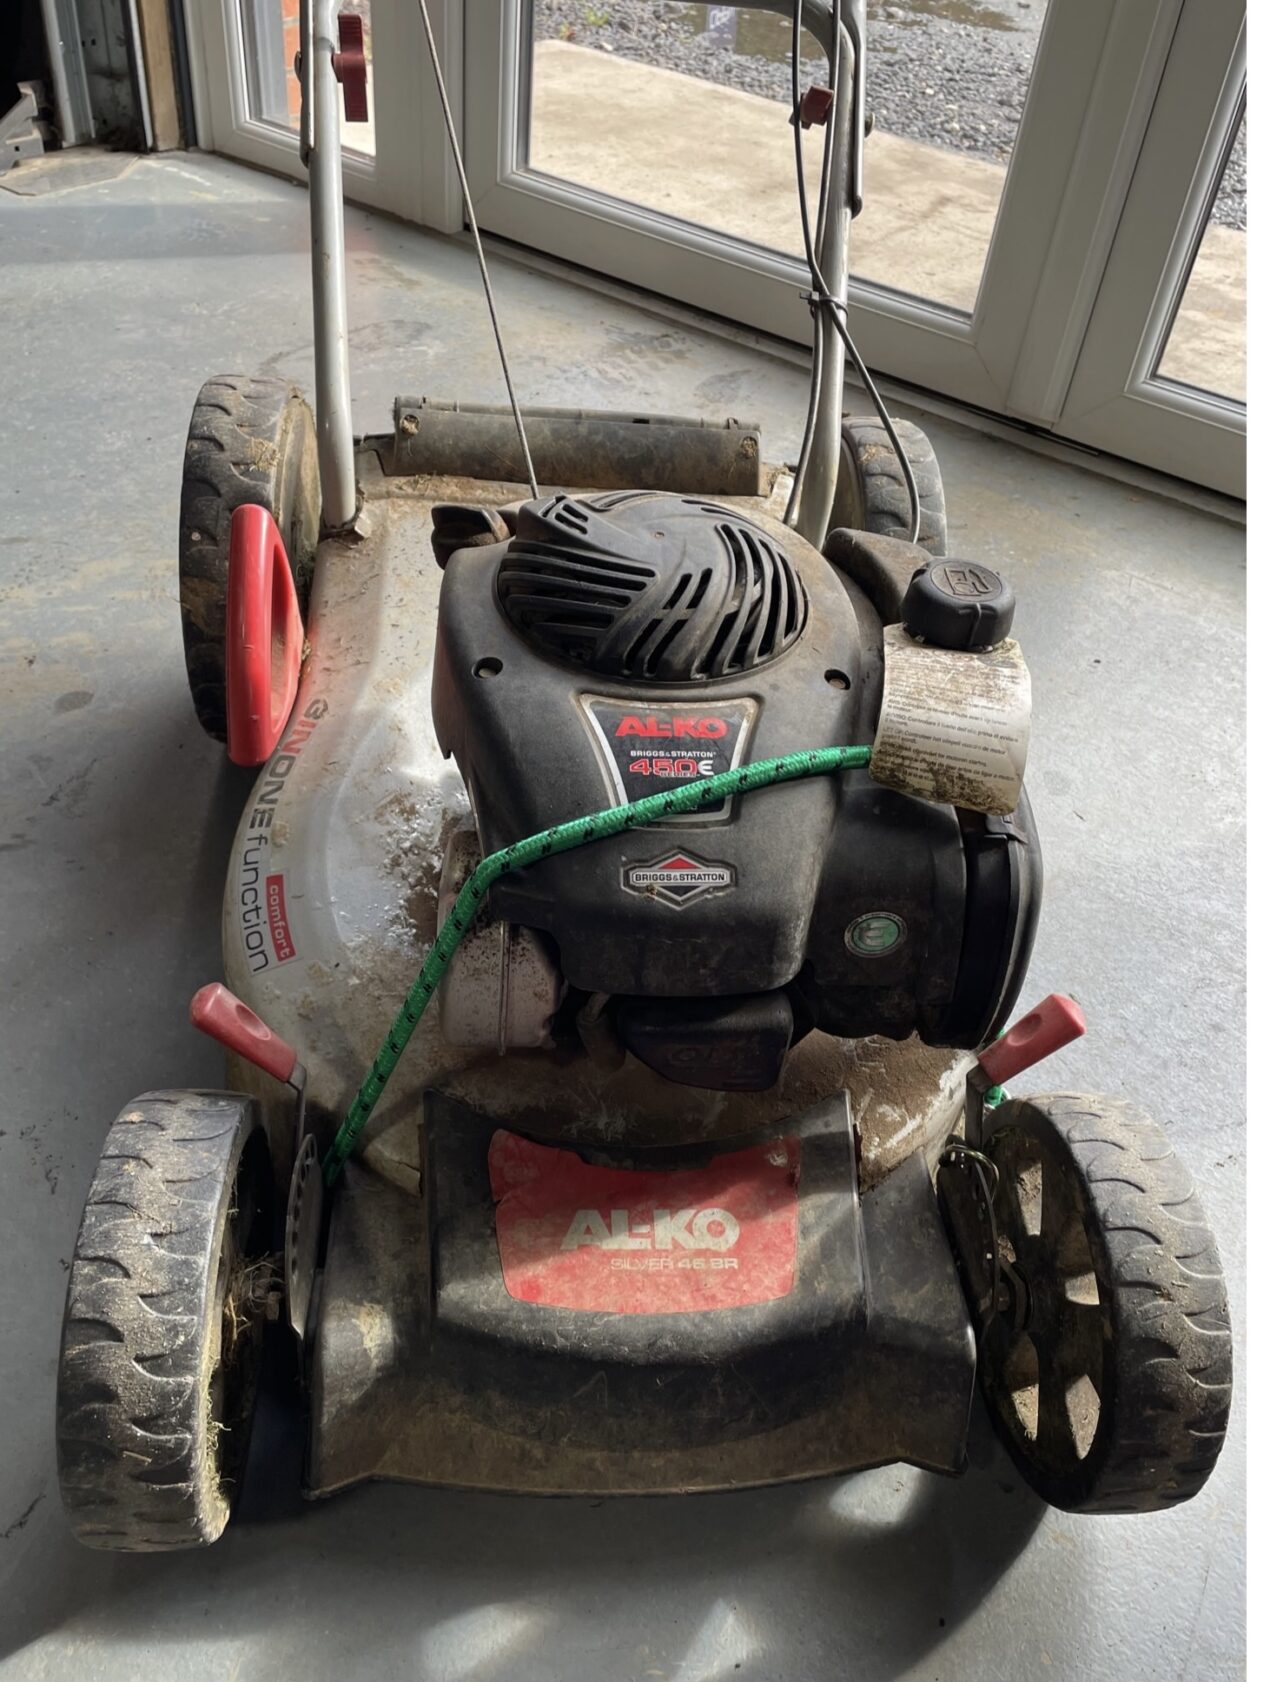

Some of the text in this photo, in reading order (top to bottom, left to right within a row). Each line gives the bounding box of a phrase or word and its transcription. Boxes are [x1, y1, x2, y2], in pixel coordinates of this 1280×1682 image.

[615, 715, 729, 739] AL-KO
[635, 872, 725, 882] BRIGGS&STRATTON
[240, 833, 270, 973] function
[269, 884, 291, 959] comfort
[560, 1207, 741, 1252] AL-KO
[610, 1257, 739, 1271] SILVER 46 BR
